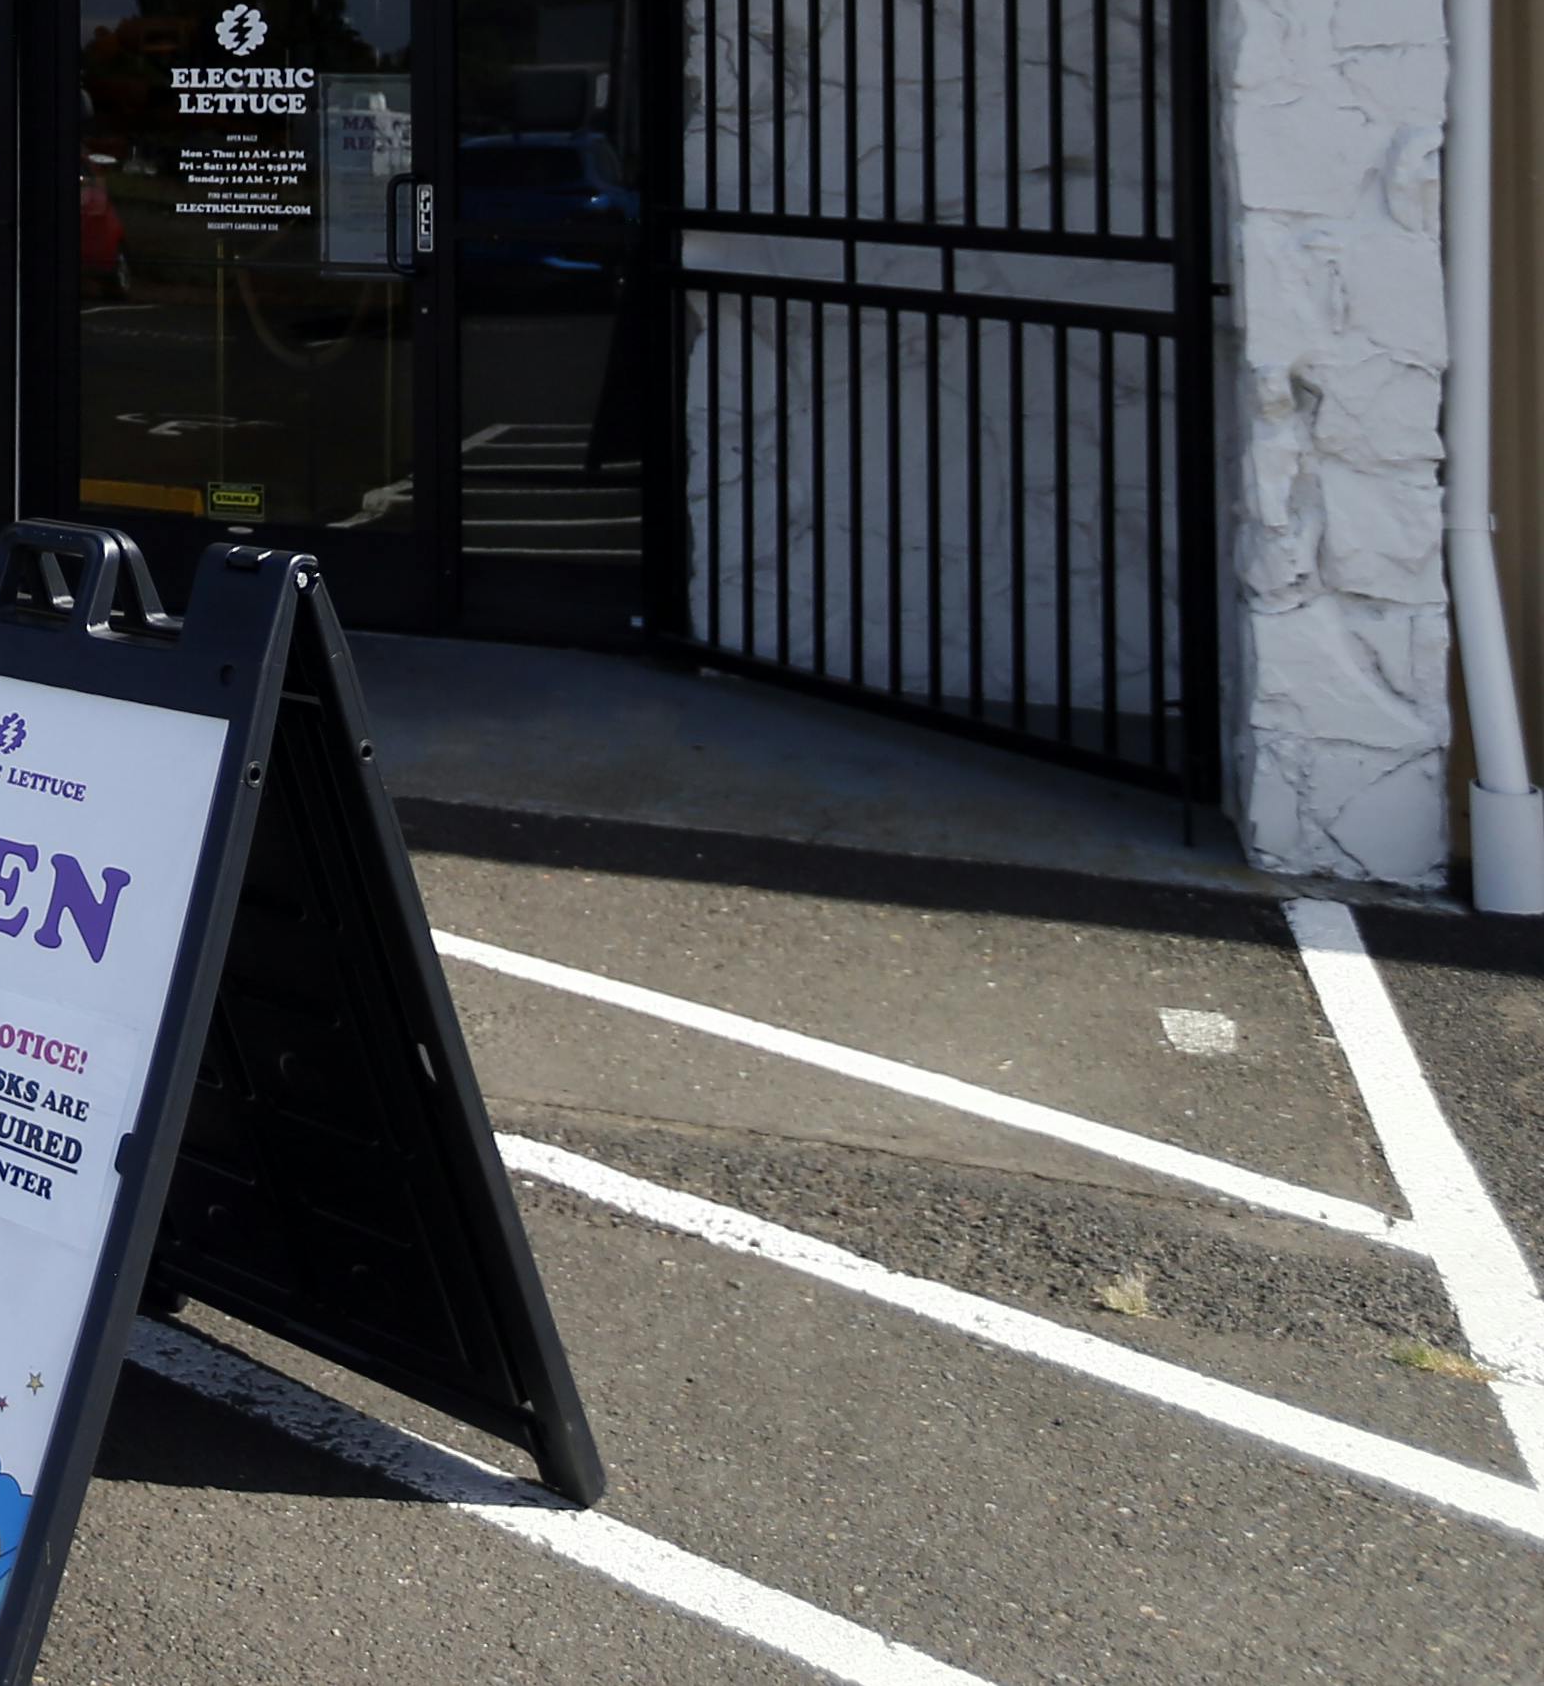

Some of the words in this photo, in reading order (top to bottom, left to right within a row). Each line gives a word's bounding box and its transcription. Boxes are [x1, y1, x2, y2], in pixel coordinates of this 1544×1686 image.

[170, 67, 315, 89] ELECTRIC
[178, 93, 308, 114] LETTUCE
[181, 149, 203, 158] Mon
[252, 150, 270, 159] AM
[288, 150, 305, 159] PM
[179, 162, 194, 171] Fri
[239, 163, 257, 171] AM
[290, 163, 307, 172] PM
[188, 175, 229, 185] Sunday:
[245, 175, 263, 184] AM
[282, 176, 298, 185] PM
[175, 203, 312, 215] ELECTRICLETTUCE.COM
[420, 190, 431, 235] PULL
[7, 767, 87, 802] LETTUCE
[41, 1089, 90, 1122] ARE
